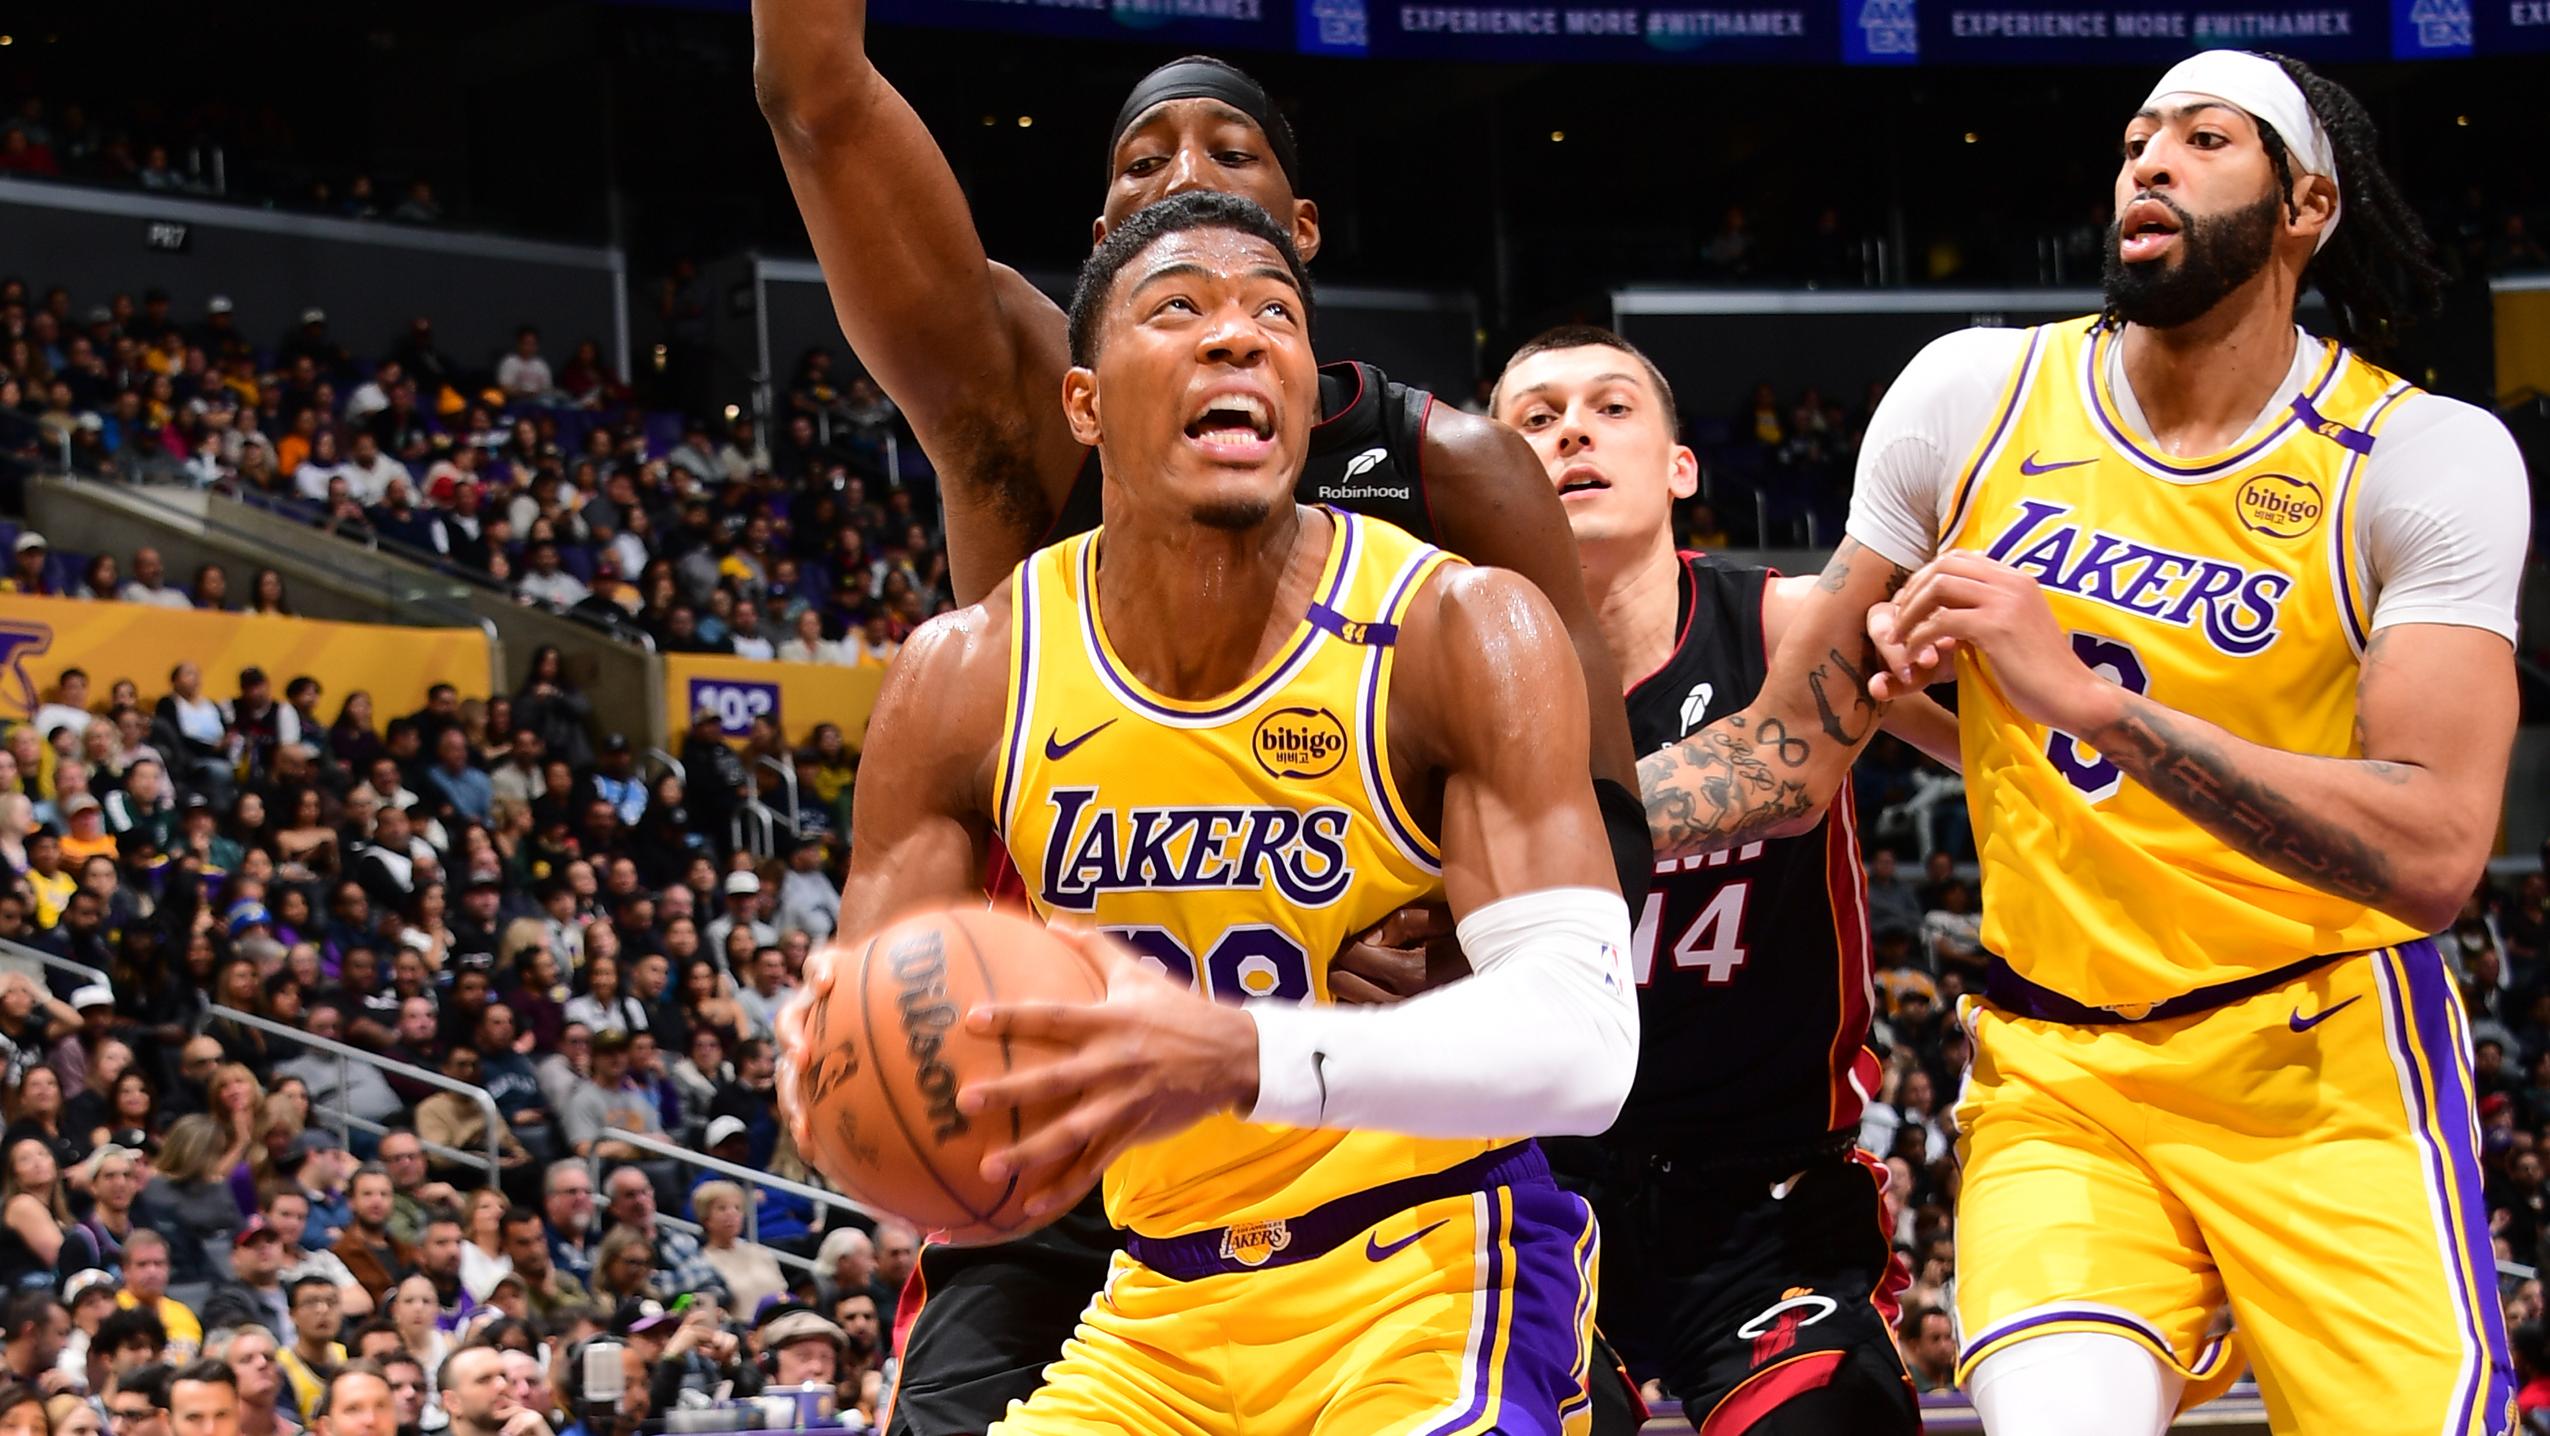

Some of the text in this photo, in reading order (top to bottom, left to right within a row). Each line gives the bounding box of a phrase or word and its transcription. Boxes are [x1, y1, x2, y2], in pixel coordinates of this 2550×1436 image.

[1401, 8, 1803, 37] EXPERIENCE MORE #WITHAMEX
[1952, 12, 2107, 38] EXPERIENCE
[2114, 13, 2185, 38] MORE
[1318, 485, 1410, 499] Robinhood
[2245, 486, 2318, 523] bibigo
[2254, 510, 2286, 525] 비비고
[1986, 497, 2294, 658] LAKERS
[1342, 622, 1368, 643] 44
[1262, 726, 1341, 759] bibigo
[1276, 752, 1310, 764] 비비고
[1041, 785, 1355, 912] LAKERS
[1630, 882, 1748, 985] 14
[889, 929, 970, 1146] Wilson
[1223, 1226, 1289, 1256] LAKERS
